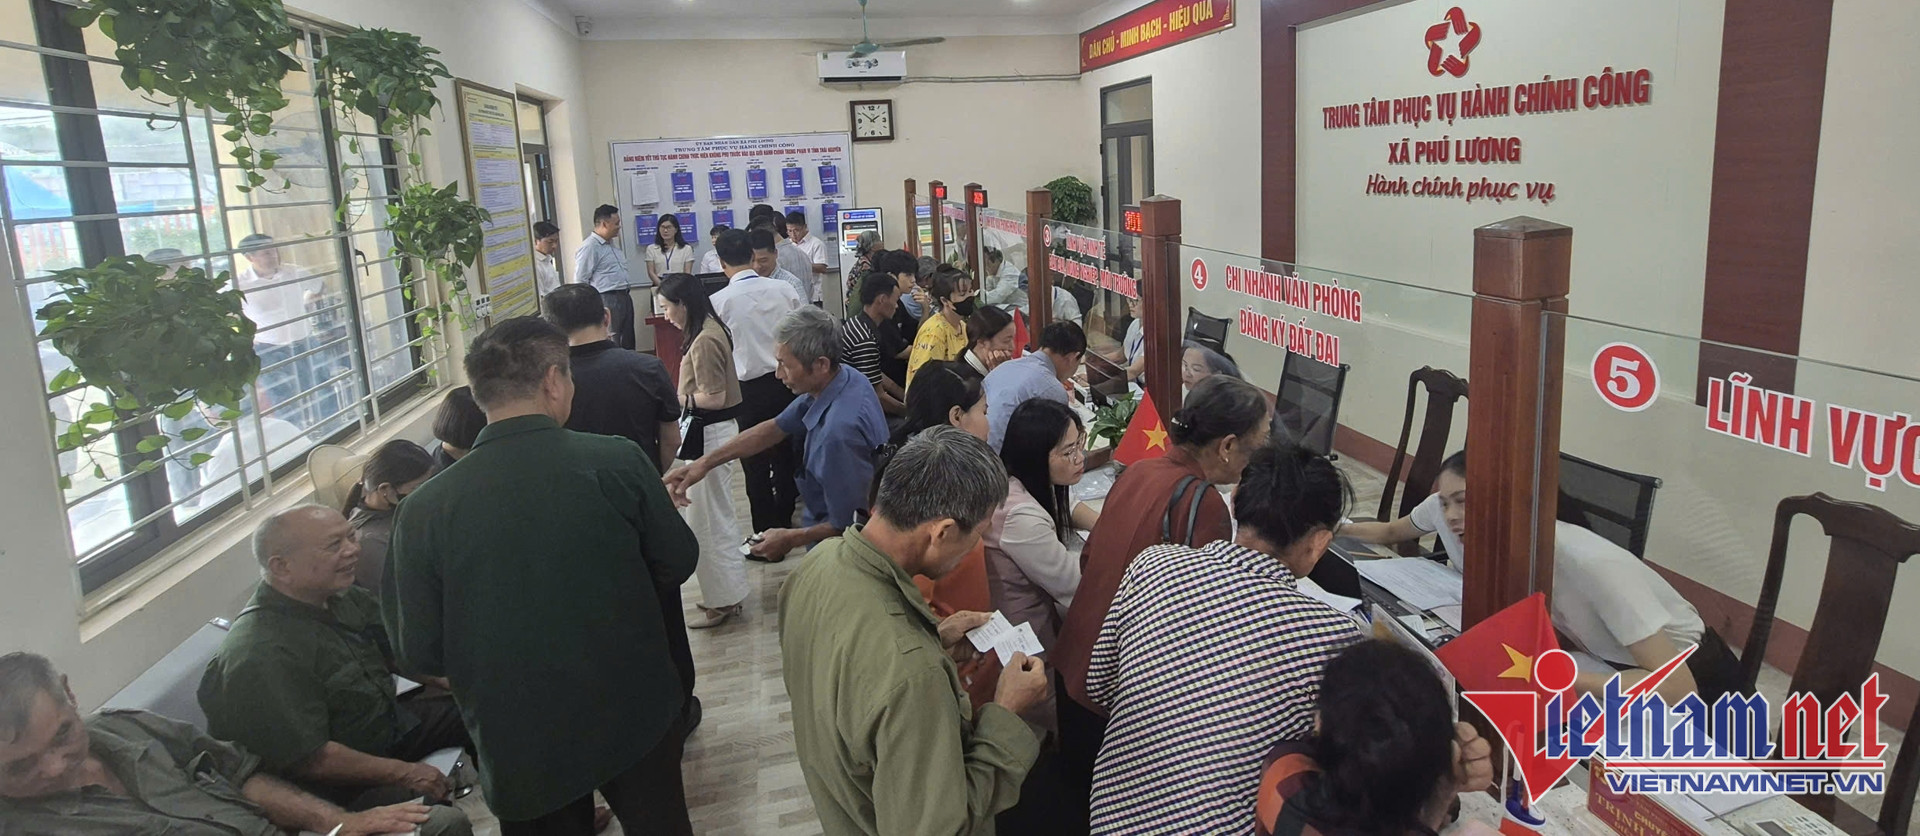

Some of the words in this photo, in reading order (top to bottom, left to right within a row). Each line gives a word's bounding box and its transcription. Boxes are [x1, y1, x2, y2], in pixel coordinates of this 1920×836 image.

[1102, 30, 1115, 55] CHỦ
[1120, 25, 1139, 49] MINH
[1140, 17, 1162, 43] BẠCH
[1169, 5, 1190, 32] HIỆU
[1323, 104, 1361, 130] TRUNG
[1363, 97, 1391, 126] TÂM
[1393, 95, 1432, 128] PHỤC
[1436, 92, 1457, 126] VỤ
[1461, 84, 1510, 118] HÀNH
[1514, 75, 1579, 116] CHÍNH
[1583, 67, 1652, 109] CÔNG
[1388, 138, 1410, 164] XÃ
[1415, 135, 1450, 164] PHÚ
[1455, 137, 1521, 164] LƯƠNG
[1366, 173, 1409, 196] Hành
[1412, 176, 1463, 197] chính
[1466, 177, 1520, 204] phục
[1526, 182, 1555, 204] vụ
[1125, 211, 1142, 231] 301
[1112, 271, 1138, 299] TRƯỜNG
[1225, 264, 1242, 292] CHI
[1244, 265, 1282, 302] NHÁNH
[1283, 272, 1310, 310] VĂN
[1313, 278, 1363, 323] PHÒNG
[1239, 306, 1269, 343] ĐĂNG
[1271, 315, 1286, 347] KÝ
[1289, 317, 1313, 357] ĐẤT
[1315, 330, 1340, 367] ĐAI
[1606, 356, 1641, 399] 5
[1706, 371, 1816, 457] LĨNH
